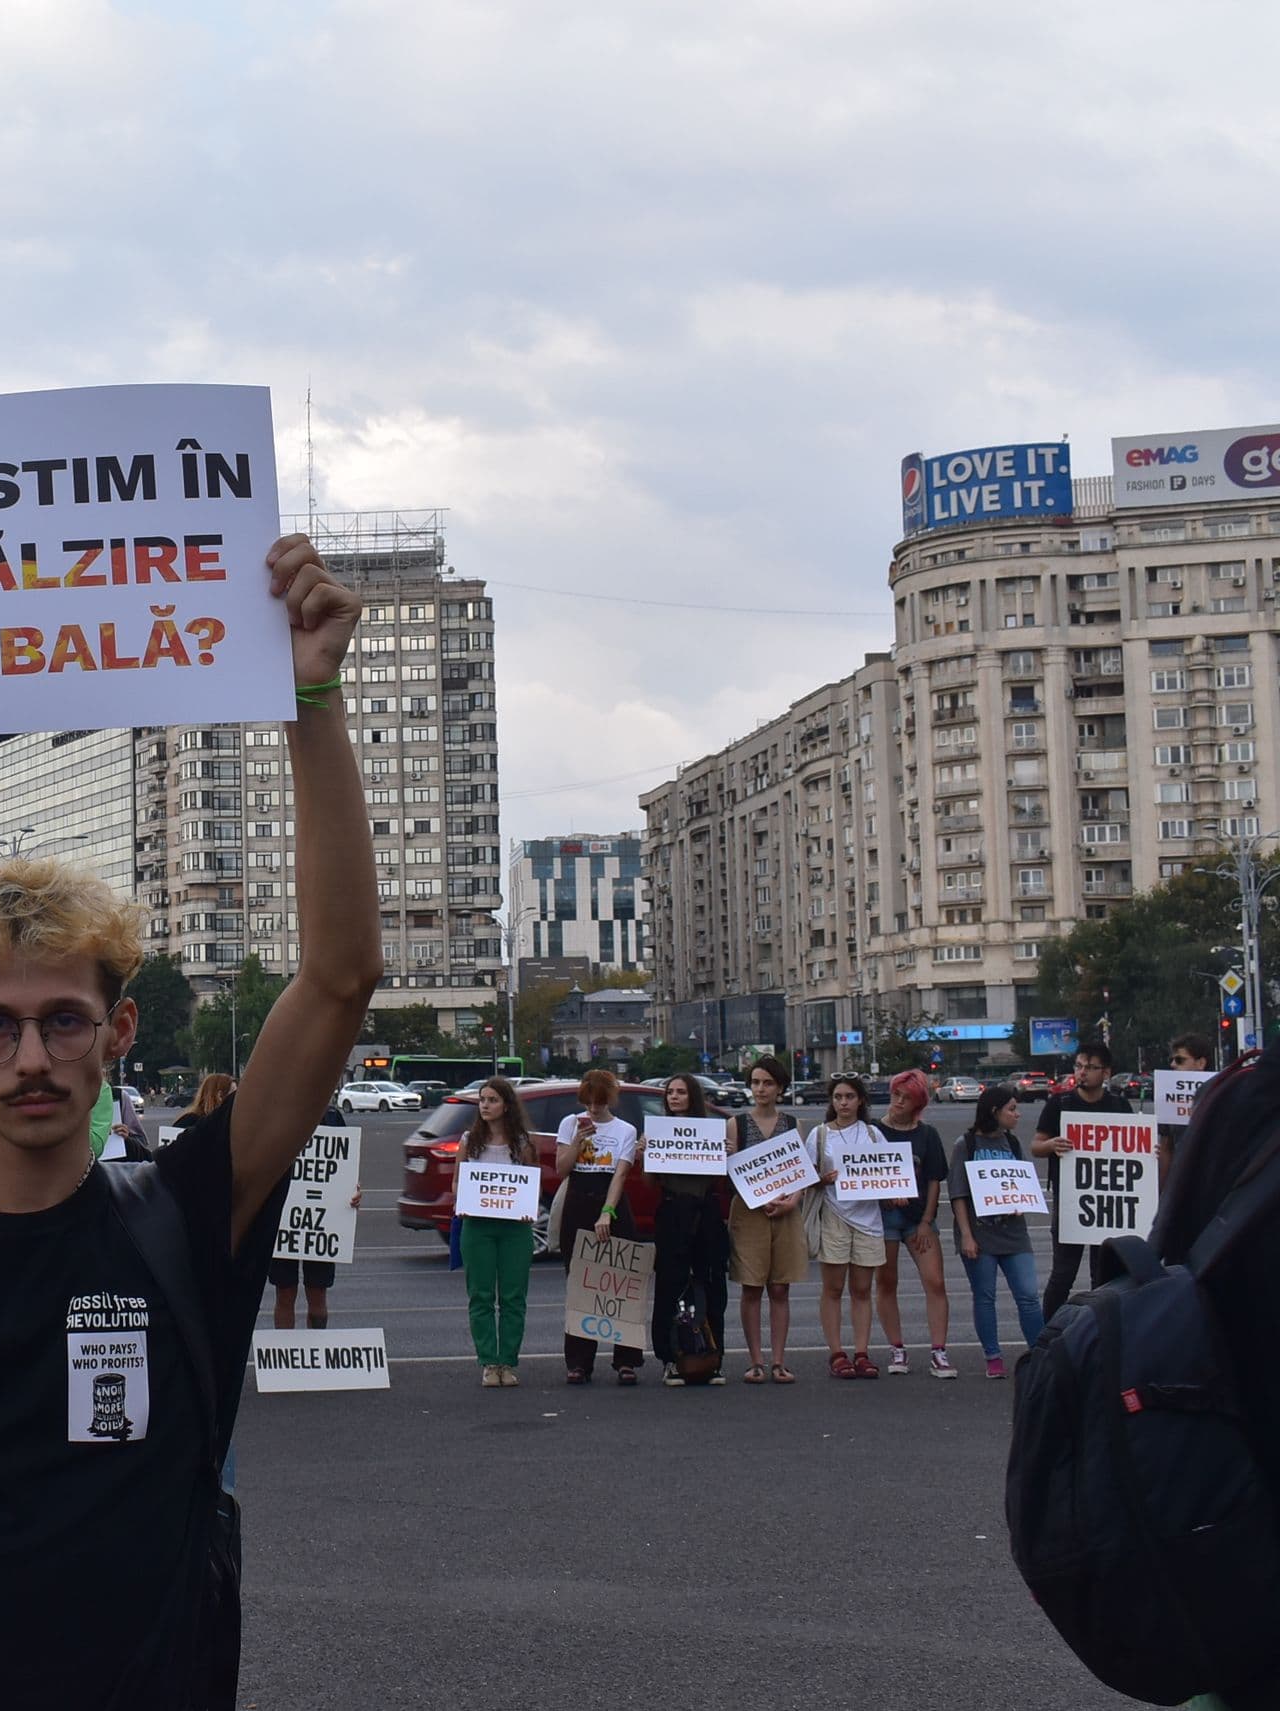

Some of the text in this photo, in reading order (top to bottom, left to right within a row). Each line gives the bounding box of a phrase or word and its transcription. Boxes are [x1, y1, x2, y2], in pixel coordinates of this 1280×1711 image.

[175, 437, 252, 499] ÎN
[932, 447, 1068, 488] LOVE IT.
[1126, 444, 1199, 468] eMAG
[1191, 475, 1216, 487] DAYS
[934, 480, 1055, 521] LIVE IT.
[673, 1127, 697, 1138] NOI
[1067, 1124, 1152, 1154] NEPTUN
[648, 1139, 723, 1151] SUPORTĂM
[734, 1140, 800, 1176] INVESTIM ÎN
[842, 1153, 903, 1164] PLANETA
[291, 1159, 338, 1183] DEEP
[470, 1171, 528, 1184] NEPTUN
[744, 1156, 802, 1186] ÎNCĂLZIRE
[753, 1169, 806, 1197] GLOBALĂ?
[845, 1165, 901, 1177] ÎNAINTE
[978, 1169, 1032, 1179] E GAZUL
[1075, 1157, 1144, 1192] DEEP
[480, 1185, 517, 1196] DEEP
[840, 1178, 910, 1190] DE PROFIT
[1001, 1179, 1019, 1191] SĂ
[480, 1197, 514, 1209] SHIT
[984, 1194, 1039, 1207] PLECAȚI
[1078, 1195, 1139, 1230] SHIT
[289, 1206, 327, 1231] GAZ
[277, 1229, 339, 1257] PE FOC
[580, 1236, 645, 1273] MAKE
[583, 1267, 642, 1299] LOVE
[68, 1291, 147, 1314] fossil free
[593, 1294, 626, 1318] NOT
[80, 1343, 137, 1355] WHO PAYS?
[257, 1347, 385, 1372] MINELE MORȚII
[72, 1357, 144, 1370] WHO PROFITS?
[97, 1402, 122, 1414] MORE
